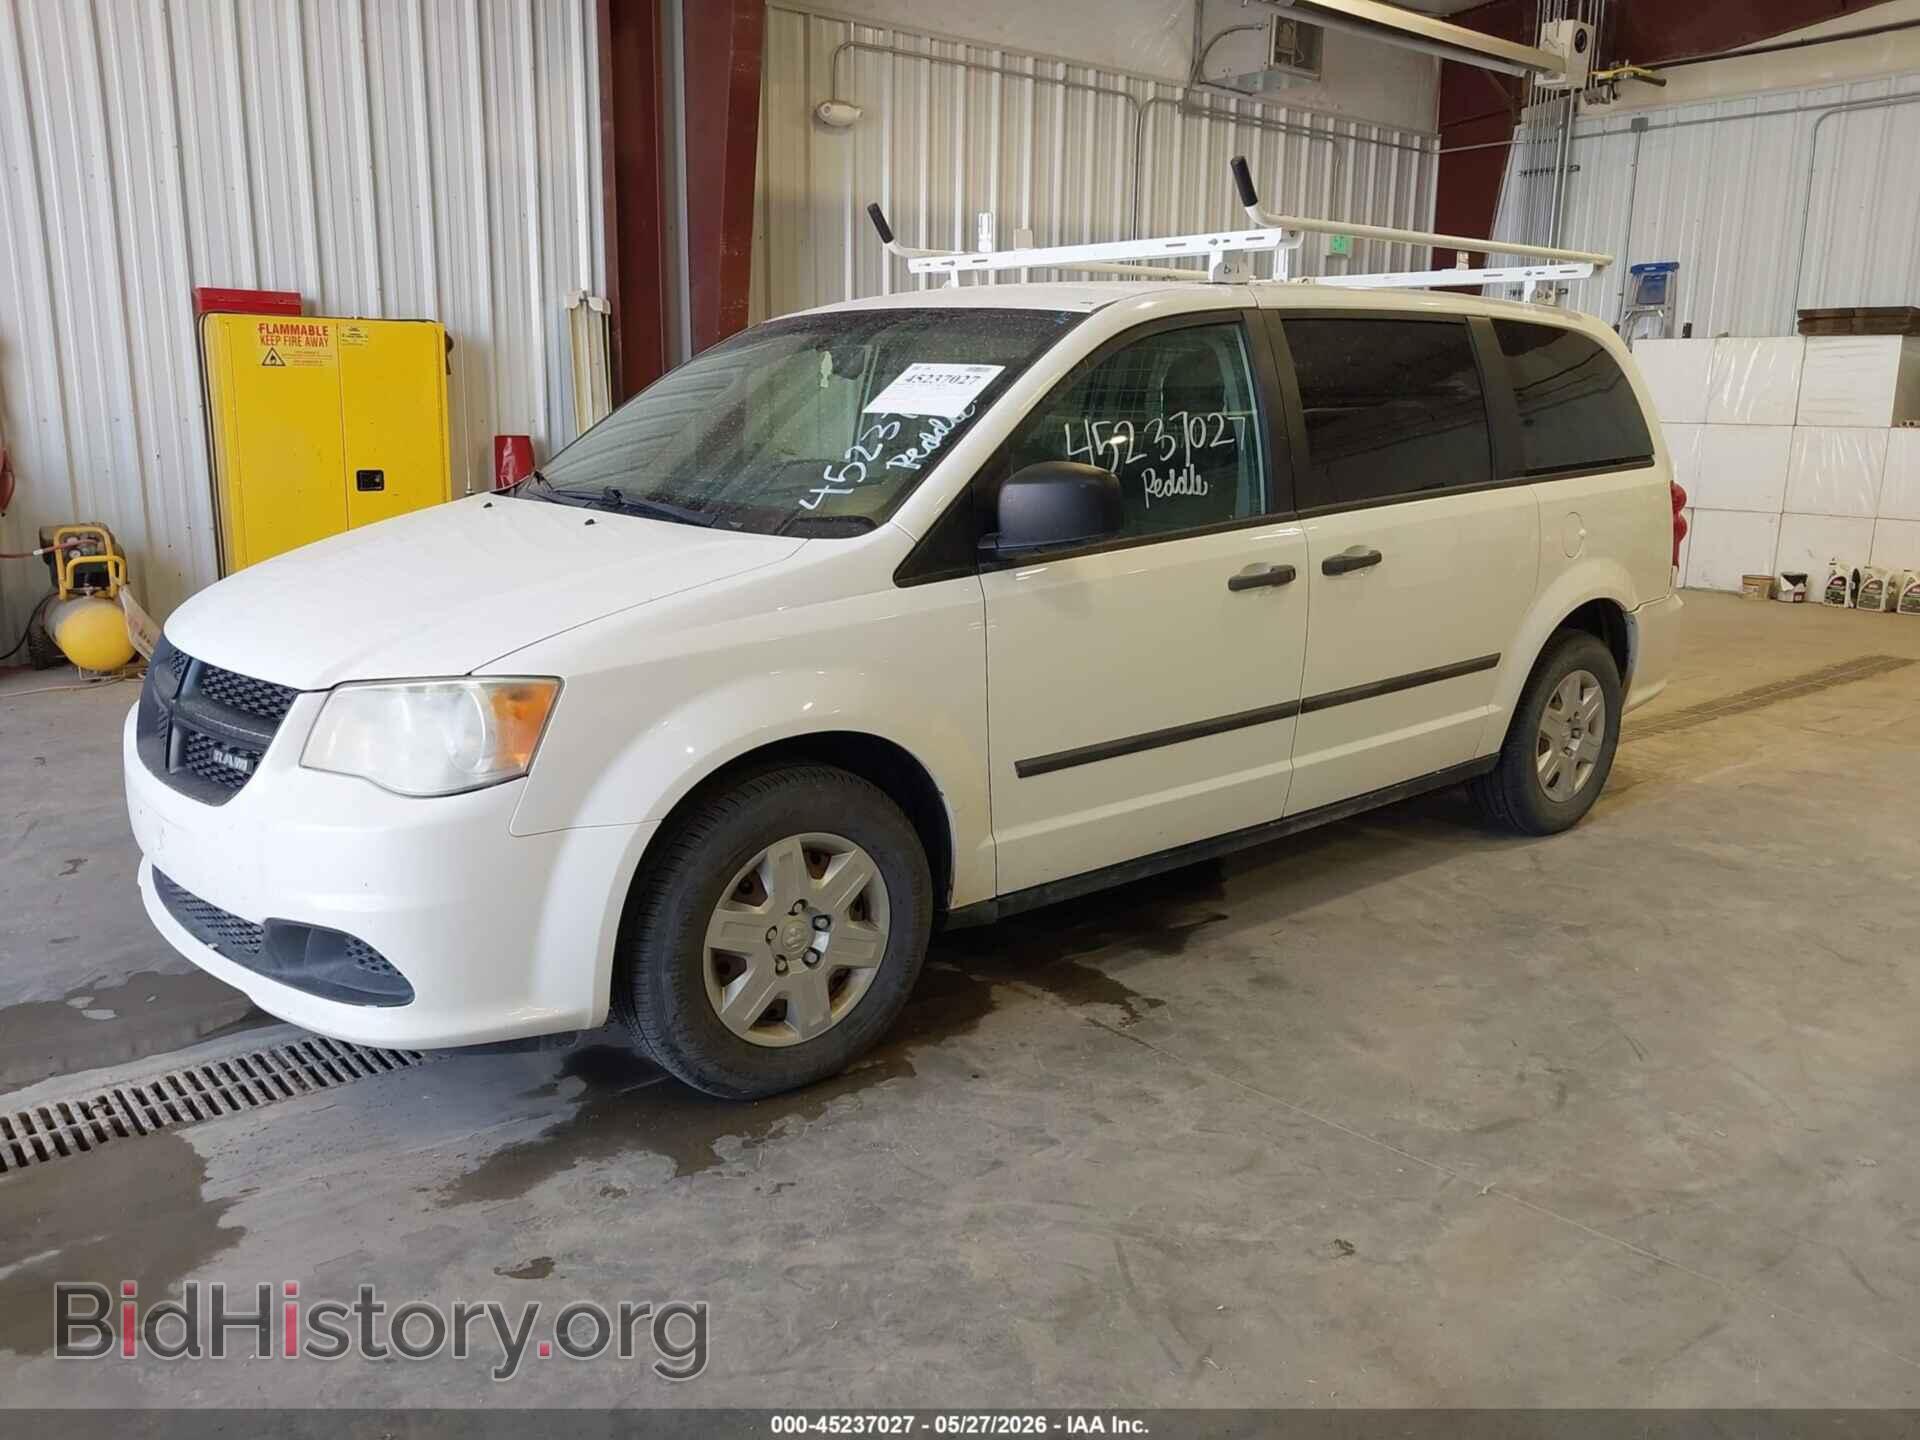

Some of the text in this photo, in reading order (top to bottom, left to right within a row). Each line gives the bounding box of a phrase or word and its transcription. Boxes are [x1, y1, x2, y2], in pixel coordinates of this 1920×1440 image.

[258, 323, 329, 336] FLAMMABLE
[260, 335, 329, 347] KEEP FIRE AWAY
[905, 374, 981, 385] 45237027
[1064, 411, 1246, 472] 45237027
[799, 412, 919, 510] 4523
[1141, 463, 1208, 509] Peddle
